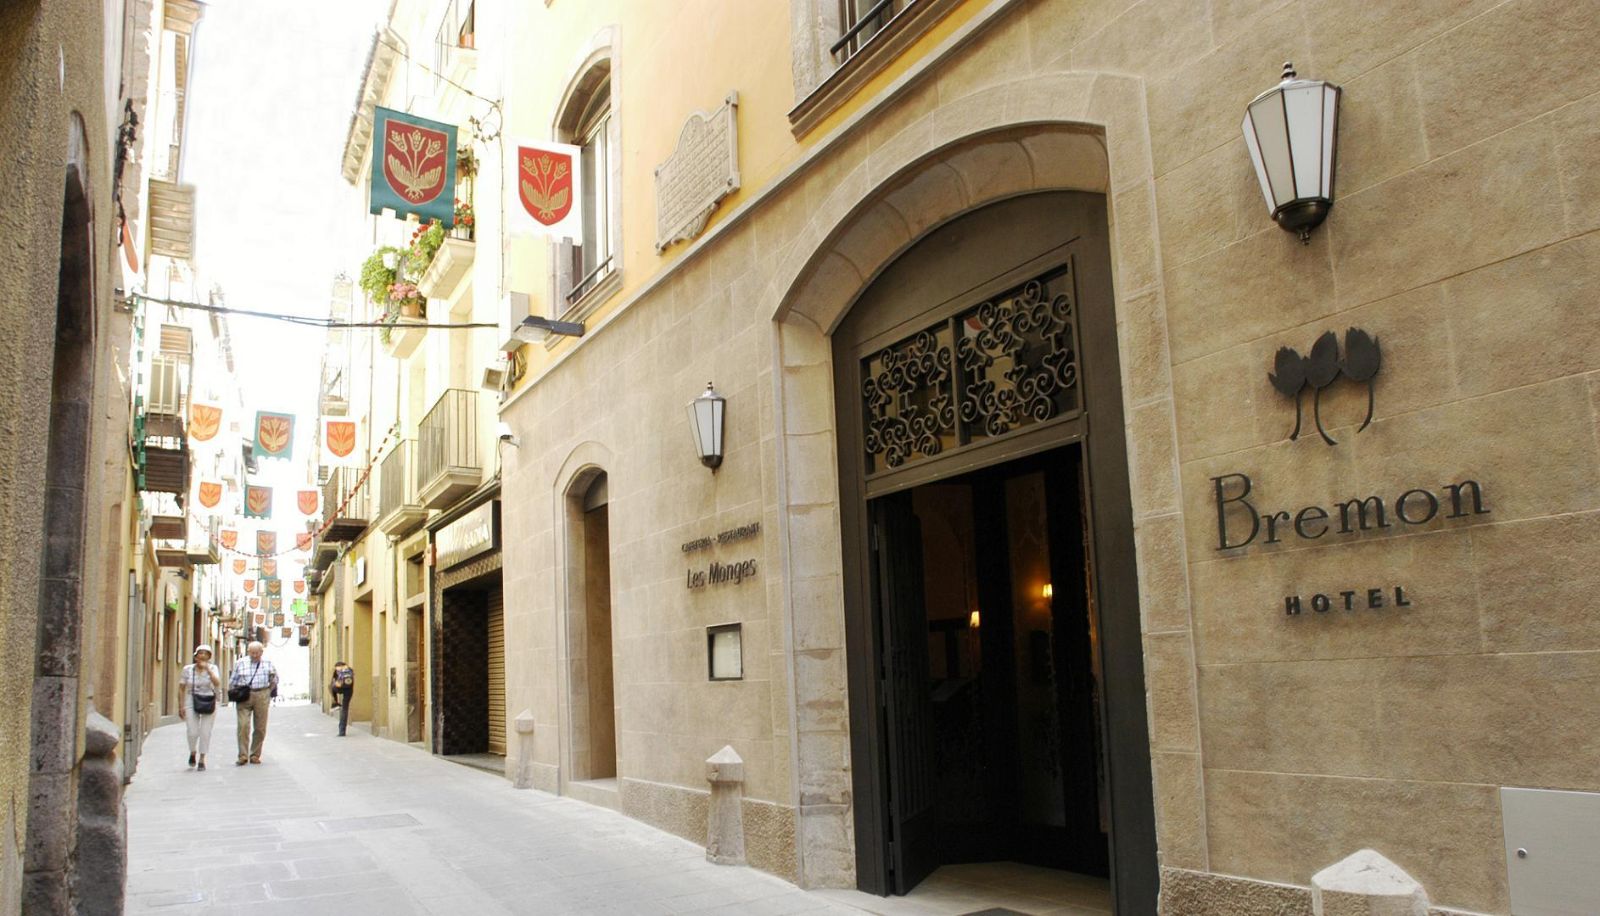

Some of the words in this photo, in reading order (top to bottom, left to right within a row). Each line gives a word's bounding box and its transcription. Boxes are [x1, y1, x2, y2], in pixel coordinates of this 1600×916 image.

[1210, 473, 1491, 551] Bremon
[687, 568, 705, 589] Les
[708, 558, 757, 585] Monges
[1285, 586, 1411, 616] HOTEL
